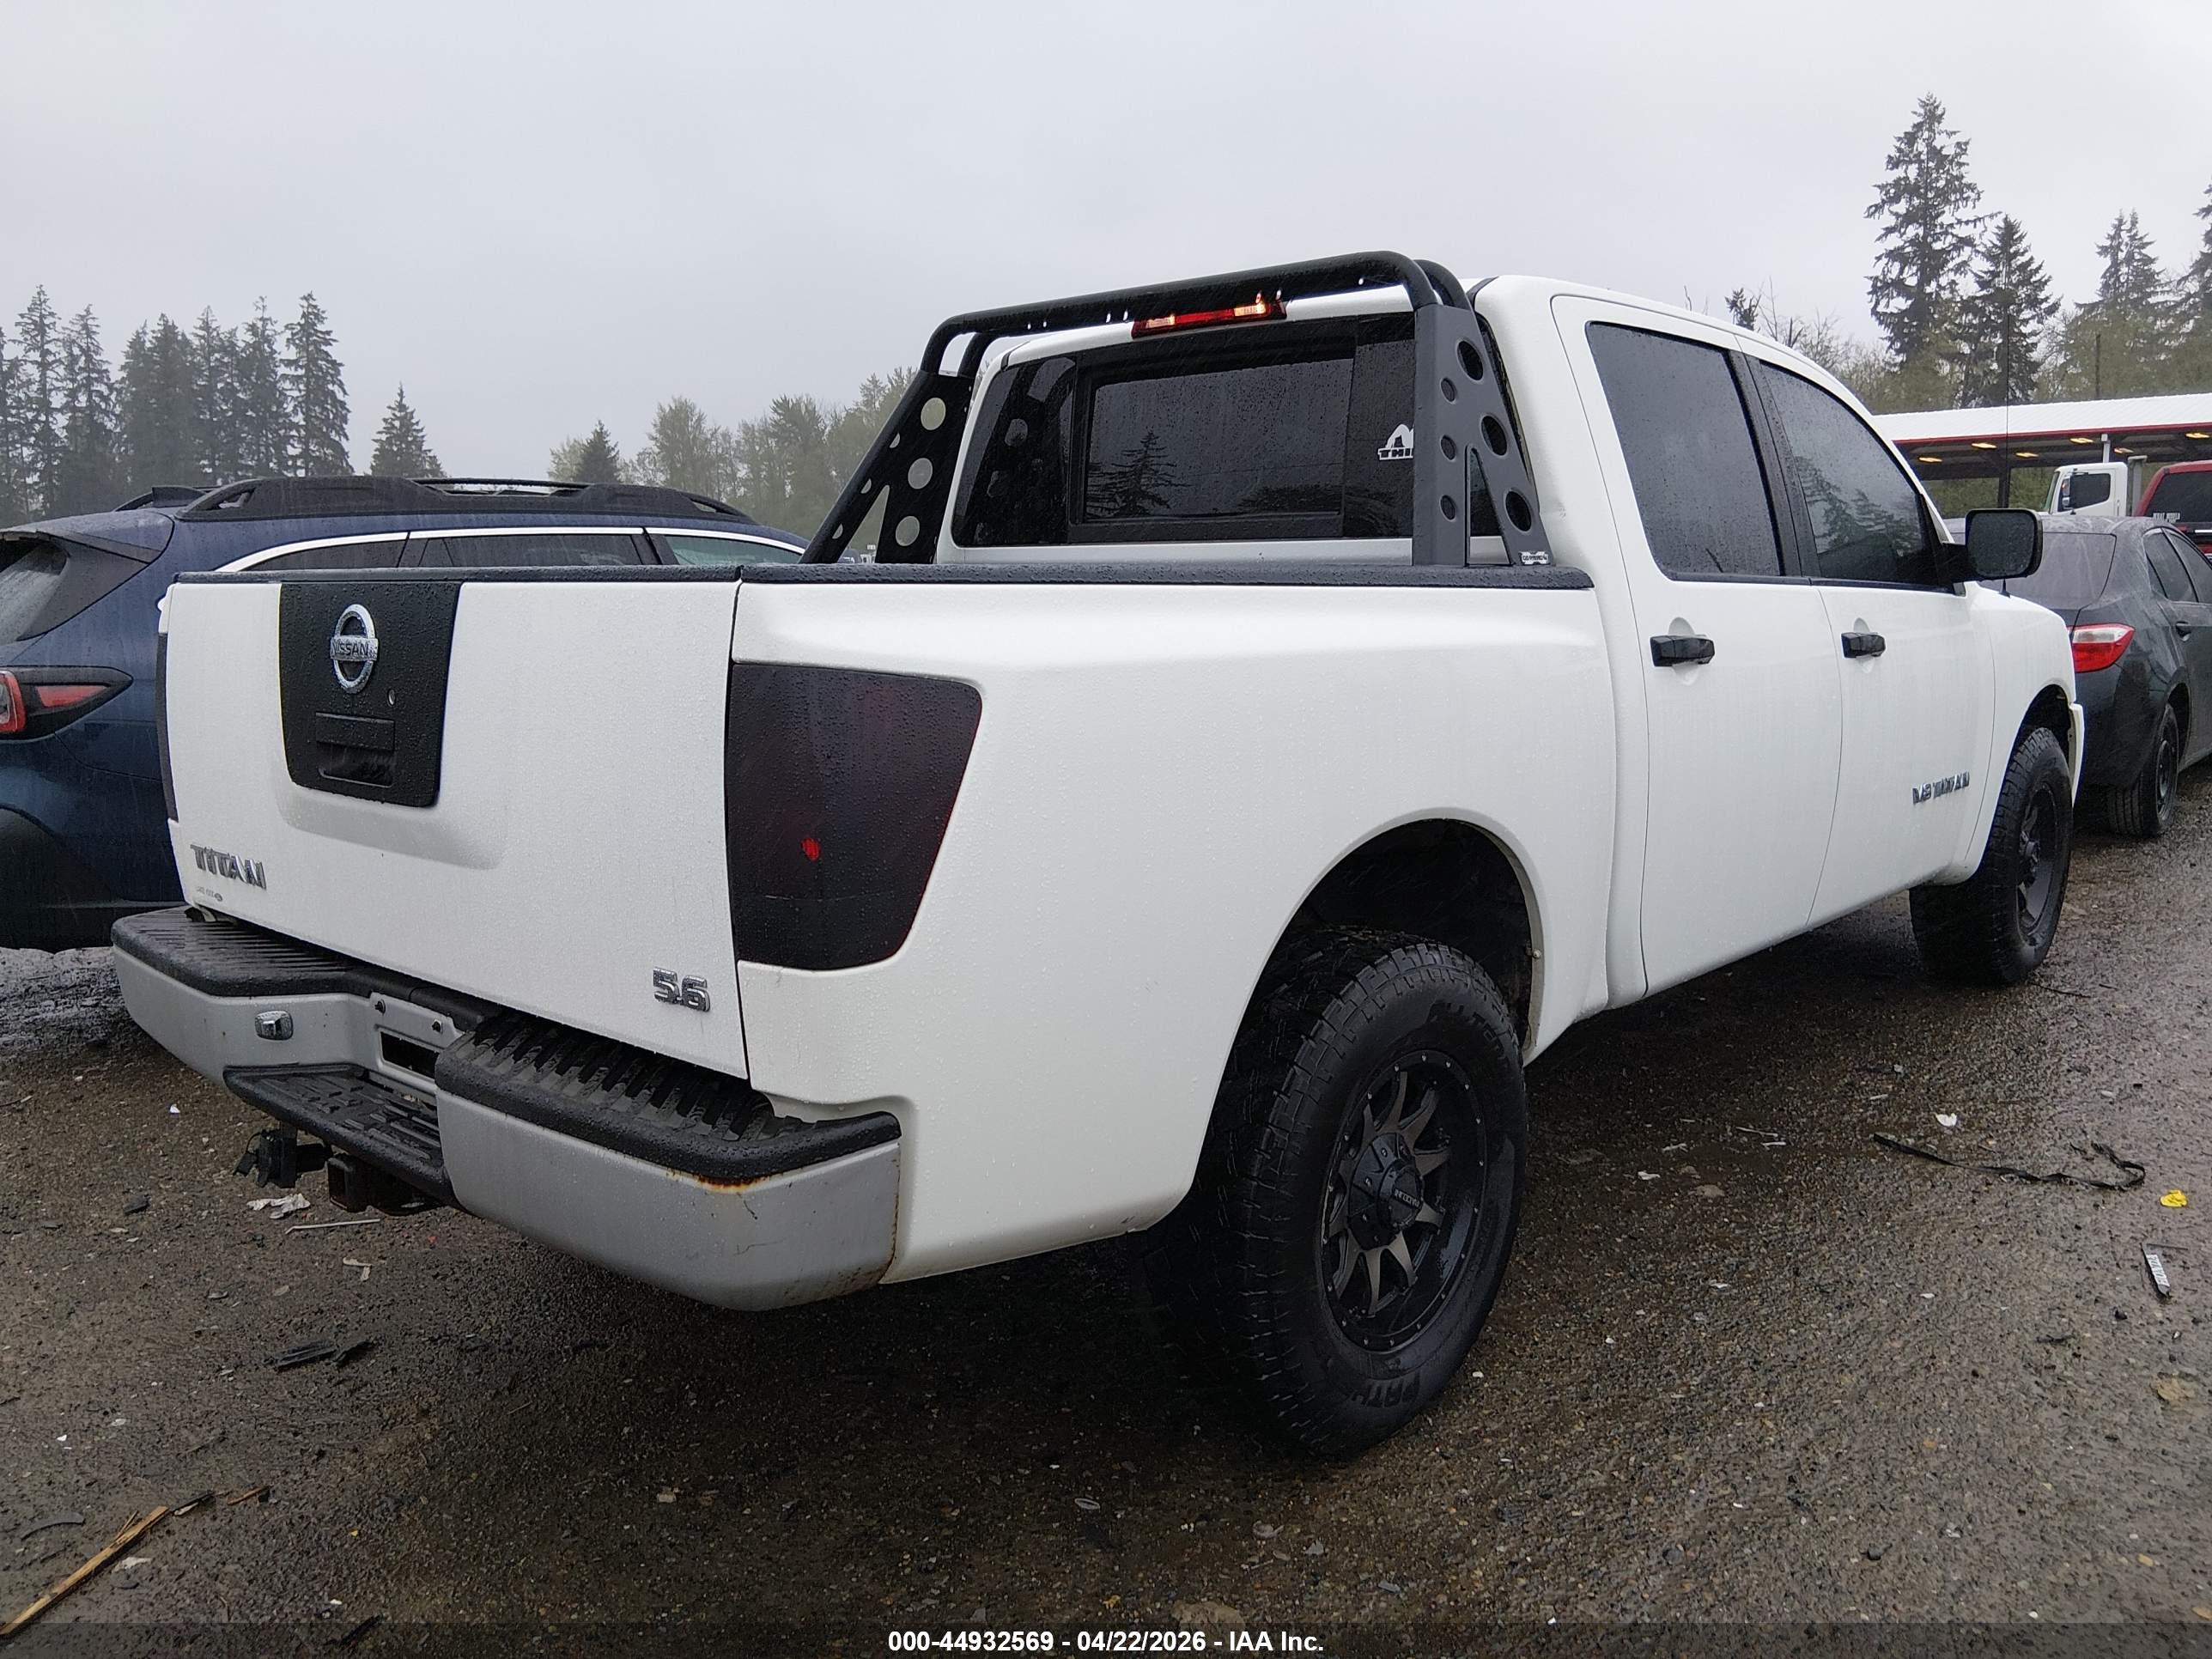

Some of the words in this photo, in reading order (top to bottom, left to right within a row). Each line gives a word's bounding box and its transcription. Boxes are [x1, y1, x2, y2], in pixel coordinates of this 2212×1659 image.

[1377, 447, 1413, 460] THI
[331, 638, 368, 657] NISSAN
[190, 843, 267, 890] TITAN
[653, 966, 711, 1013] 5.6
